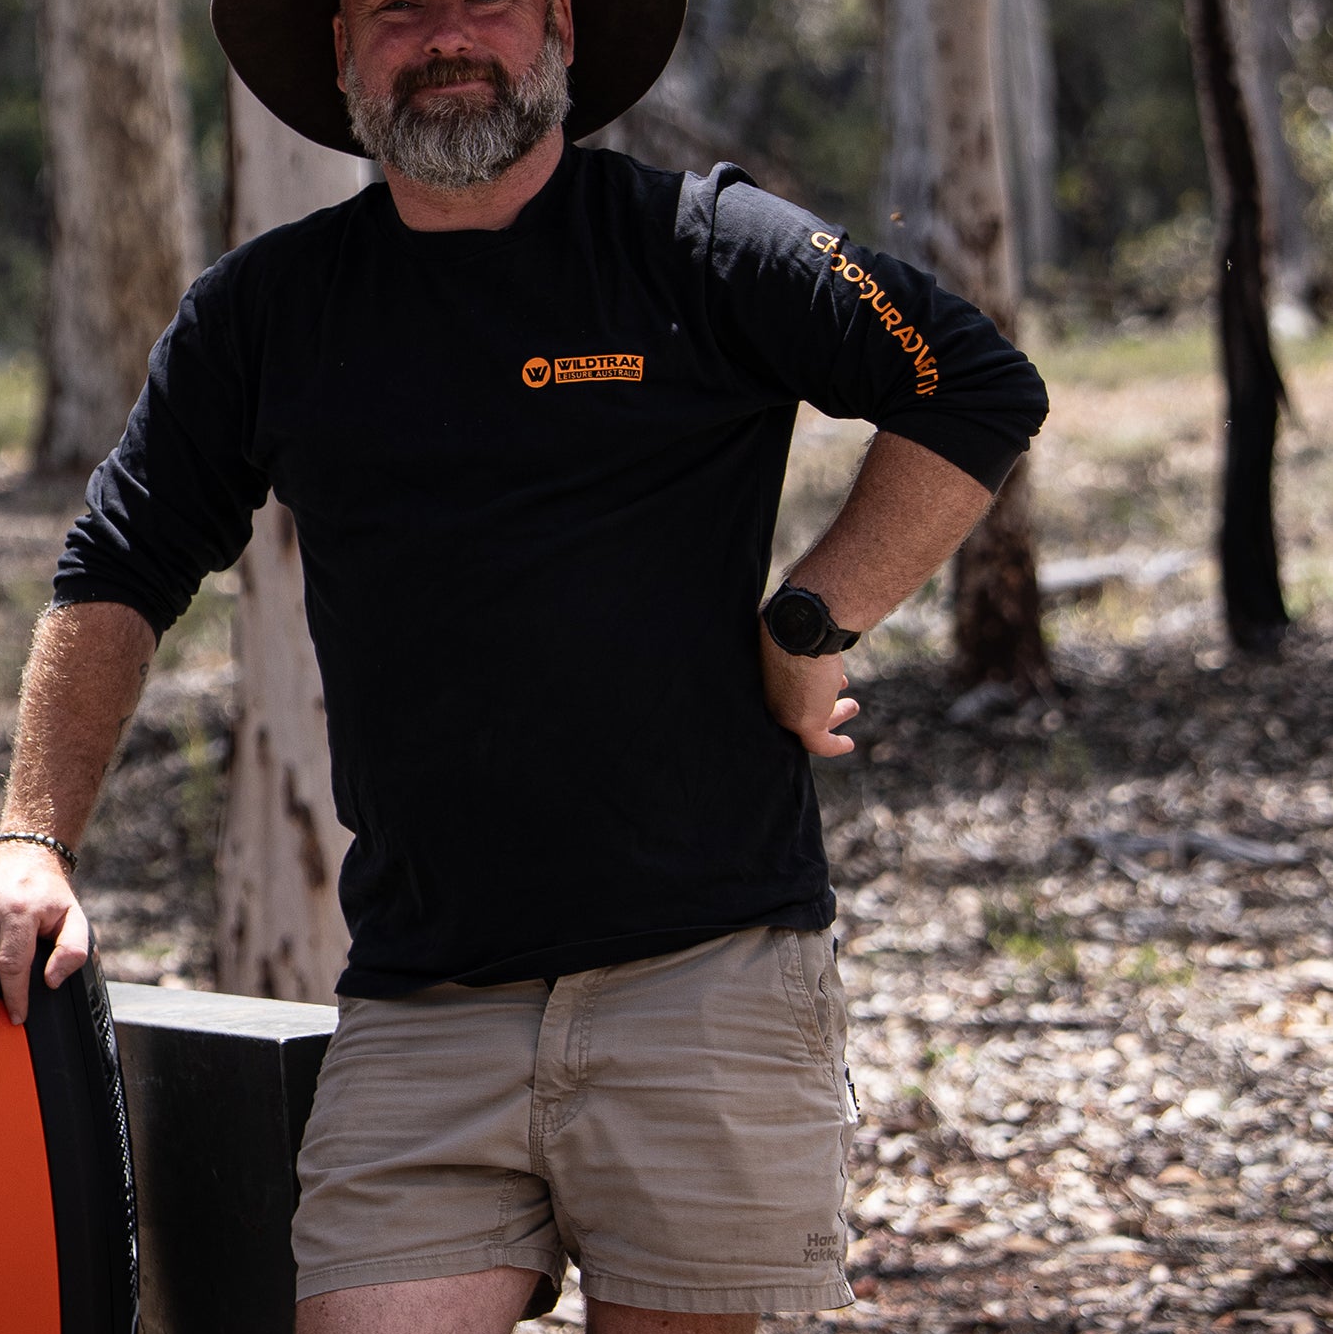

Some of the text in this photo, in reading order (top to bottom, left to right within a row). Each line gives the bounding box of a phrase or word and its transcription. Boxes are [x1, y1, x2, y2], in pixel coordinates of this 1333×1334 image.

[557, 357, 641, 370] WILDTRAK
[558, 369, 640, 380] LEISURE AUSTRALIA
